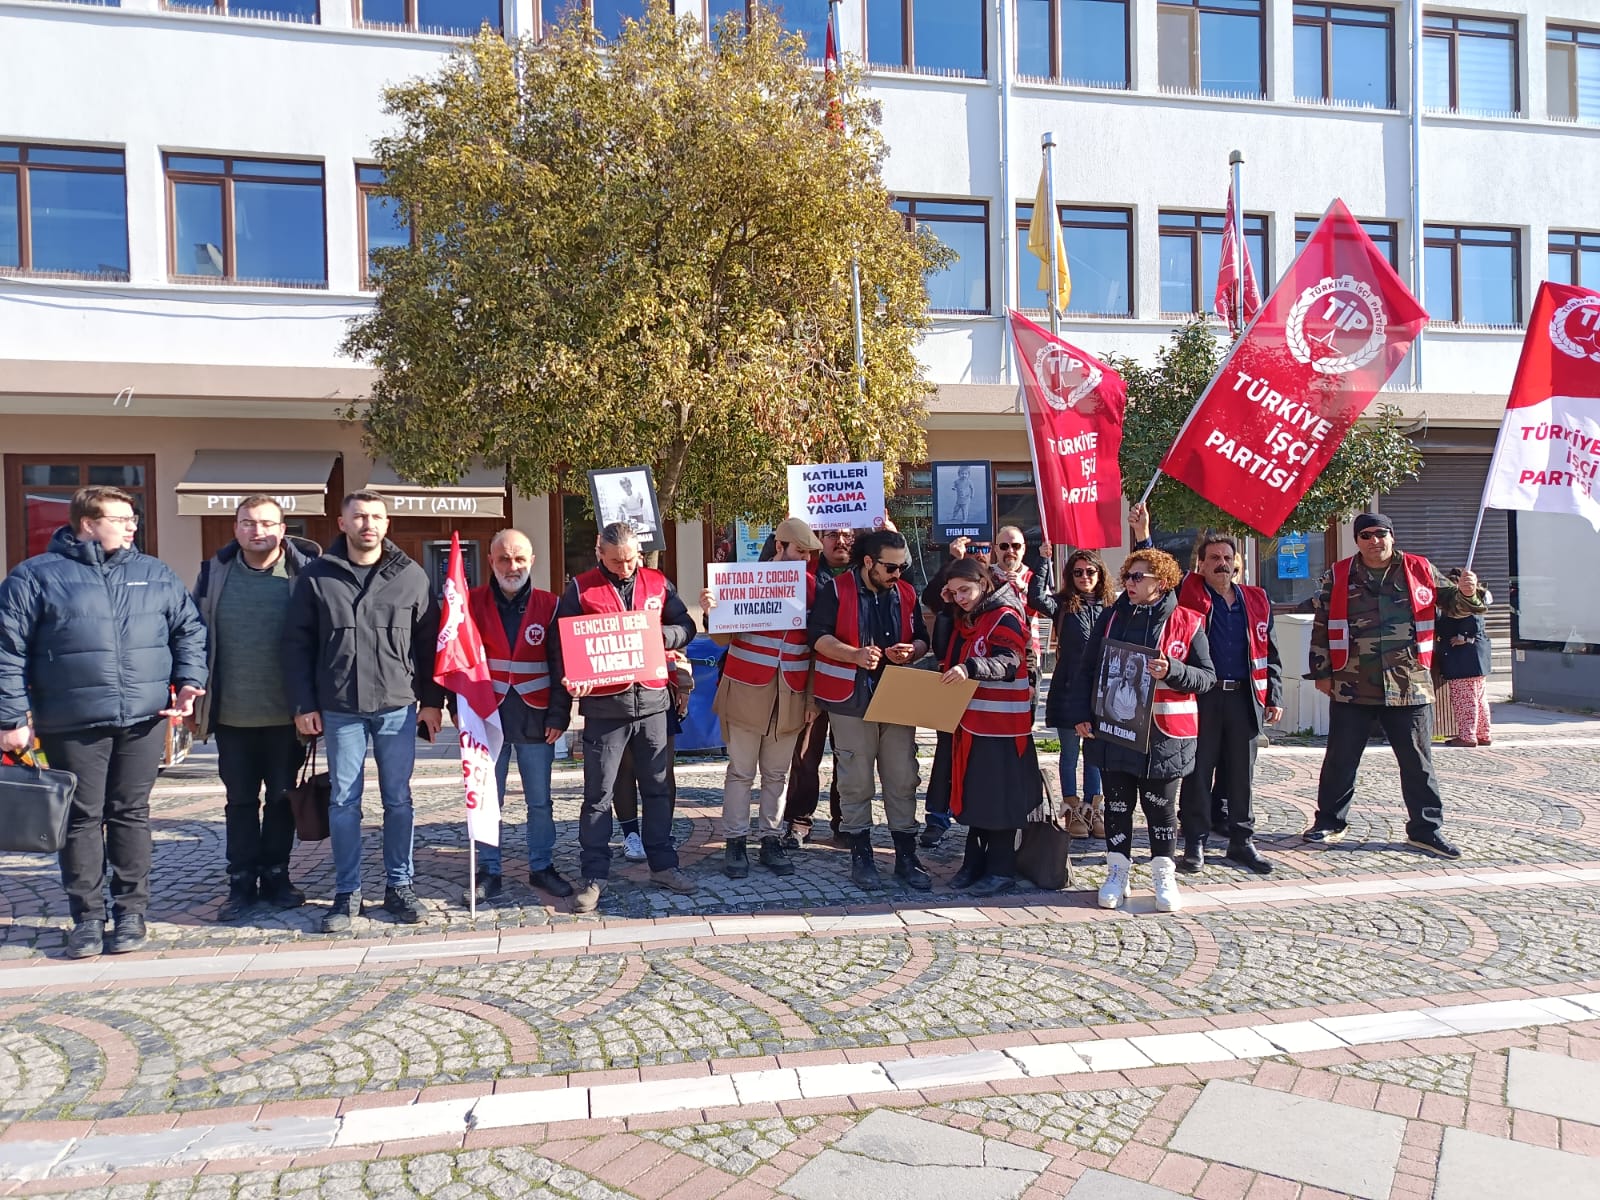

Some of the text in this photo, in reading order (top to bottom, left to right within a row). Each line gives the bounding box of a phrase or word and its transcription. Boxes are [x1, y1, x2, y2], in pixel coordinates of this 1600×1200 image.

[1309, 281, 1350, 299] TÜRKİYE
[1370, 301, 1383, 336] PARTİSİ
[1322, 296, 1368, 332] TİP
[1048, 354, 1083, 375] TİP
[1233, 371, 1333, 441] TÜRKİYE
[1047, 430, 1098, 456] TÜRKİYE
[1264, 422, 1319, 466] İŞÇİ
[1205, 429, 1300, 493] PARTİSİ
[803, 466, 868, 481] KATİLLERİ
[808, 481, 864, 493] KORUMA
[207, 495, 241, 508] PTT
[394, 497, 477, 514] PTT (ATM)
[807, 492, 866, 504] AK'LAMA
[806, 502, 867, 515] YARGILA!
[715, 571, 754, 585] HAFTADA
[757, 571, 763, 583] 2
[719, 587, 746, 600] KIYAN
[734, 601, 782, 615] KIYACAĞIZ!
